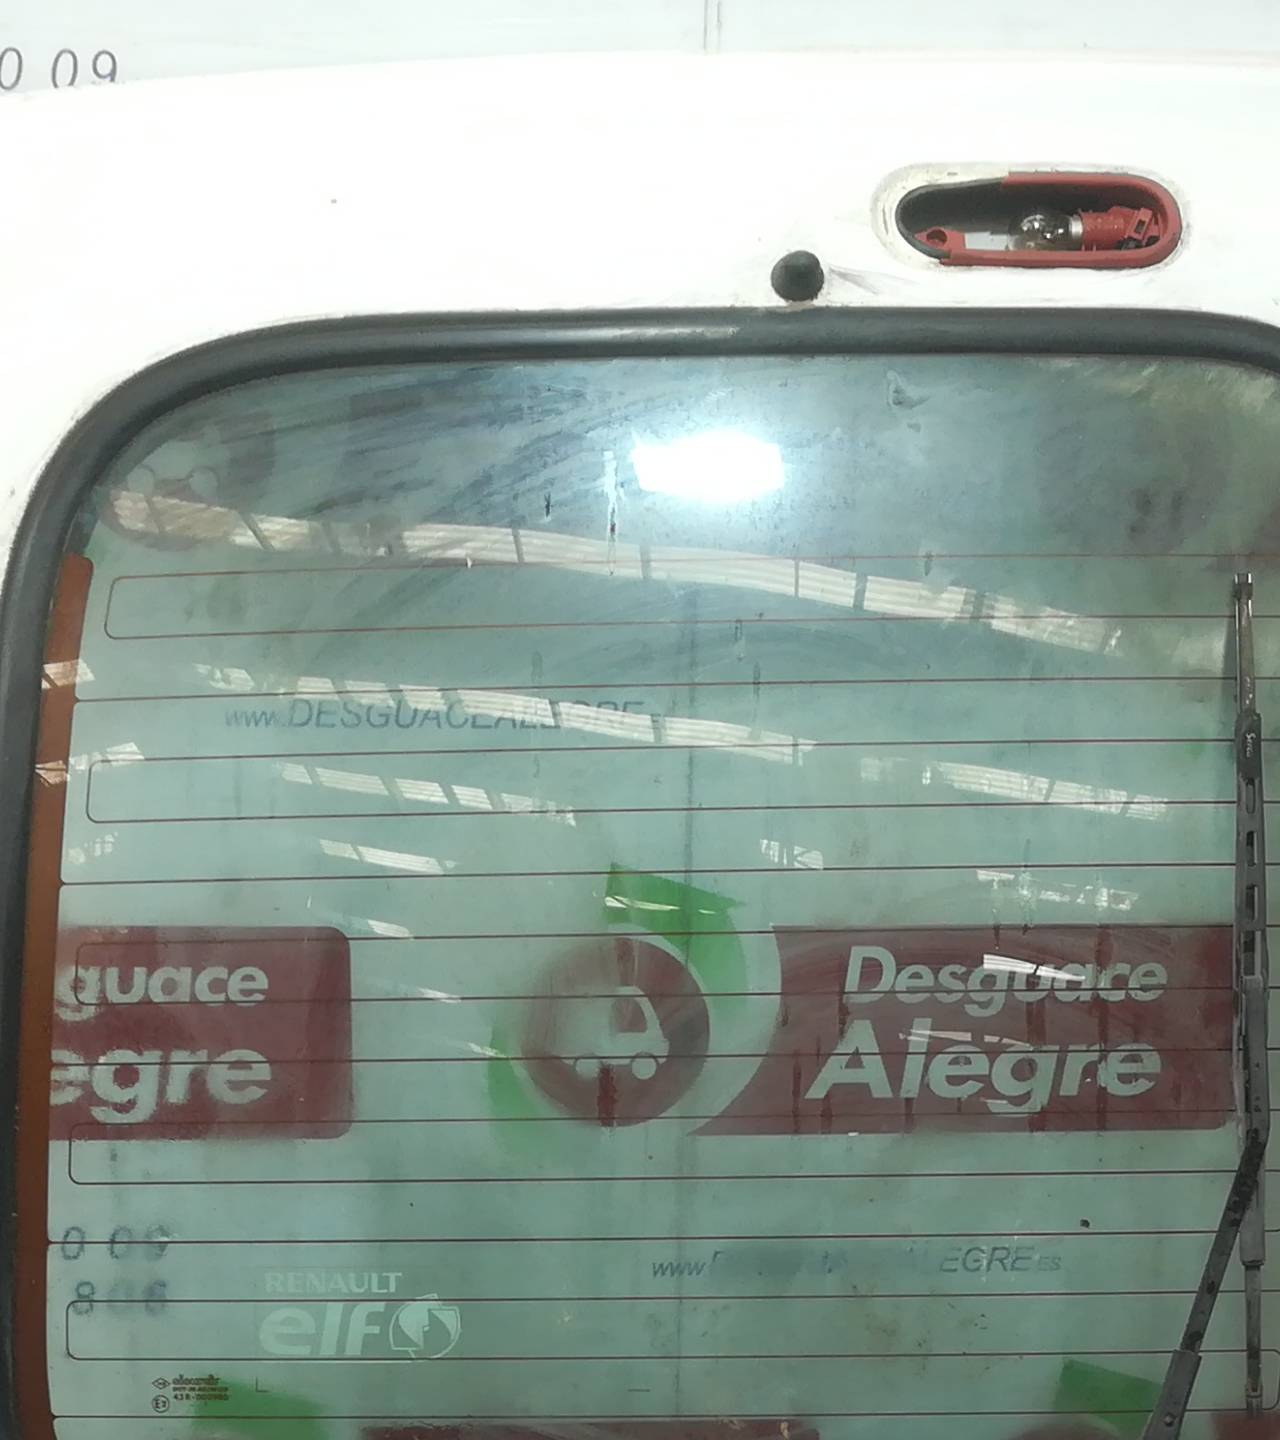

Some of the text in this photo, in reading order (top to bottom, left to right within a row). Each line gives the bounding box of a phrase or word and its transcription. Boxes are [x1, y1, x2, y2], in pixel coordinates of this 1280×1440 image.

[53, 965, 270, 1022] guace
[843, 945, 1169, 1017] Desguace
[49, 1047, 272, 1125] egre
[804, 1018, 1162, 1116] Alegre
[264, 1272, 403, 1294] RENAULT
[258, 1300, 386, 1357] elf
